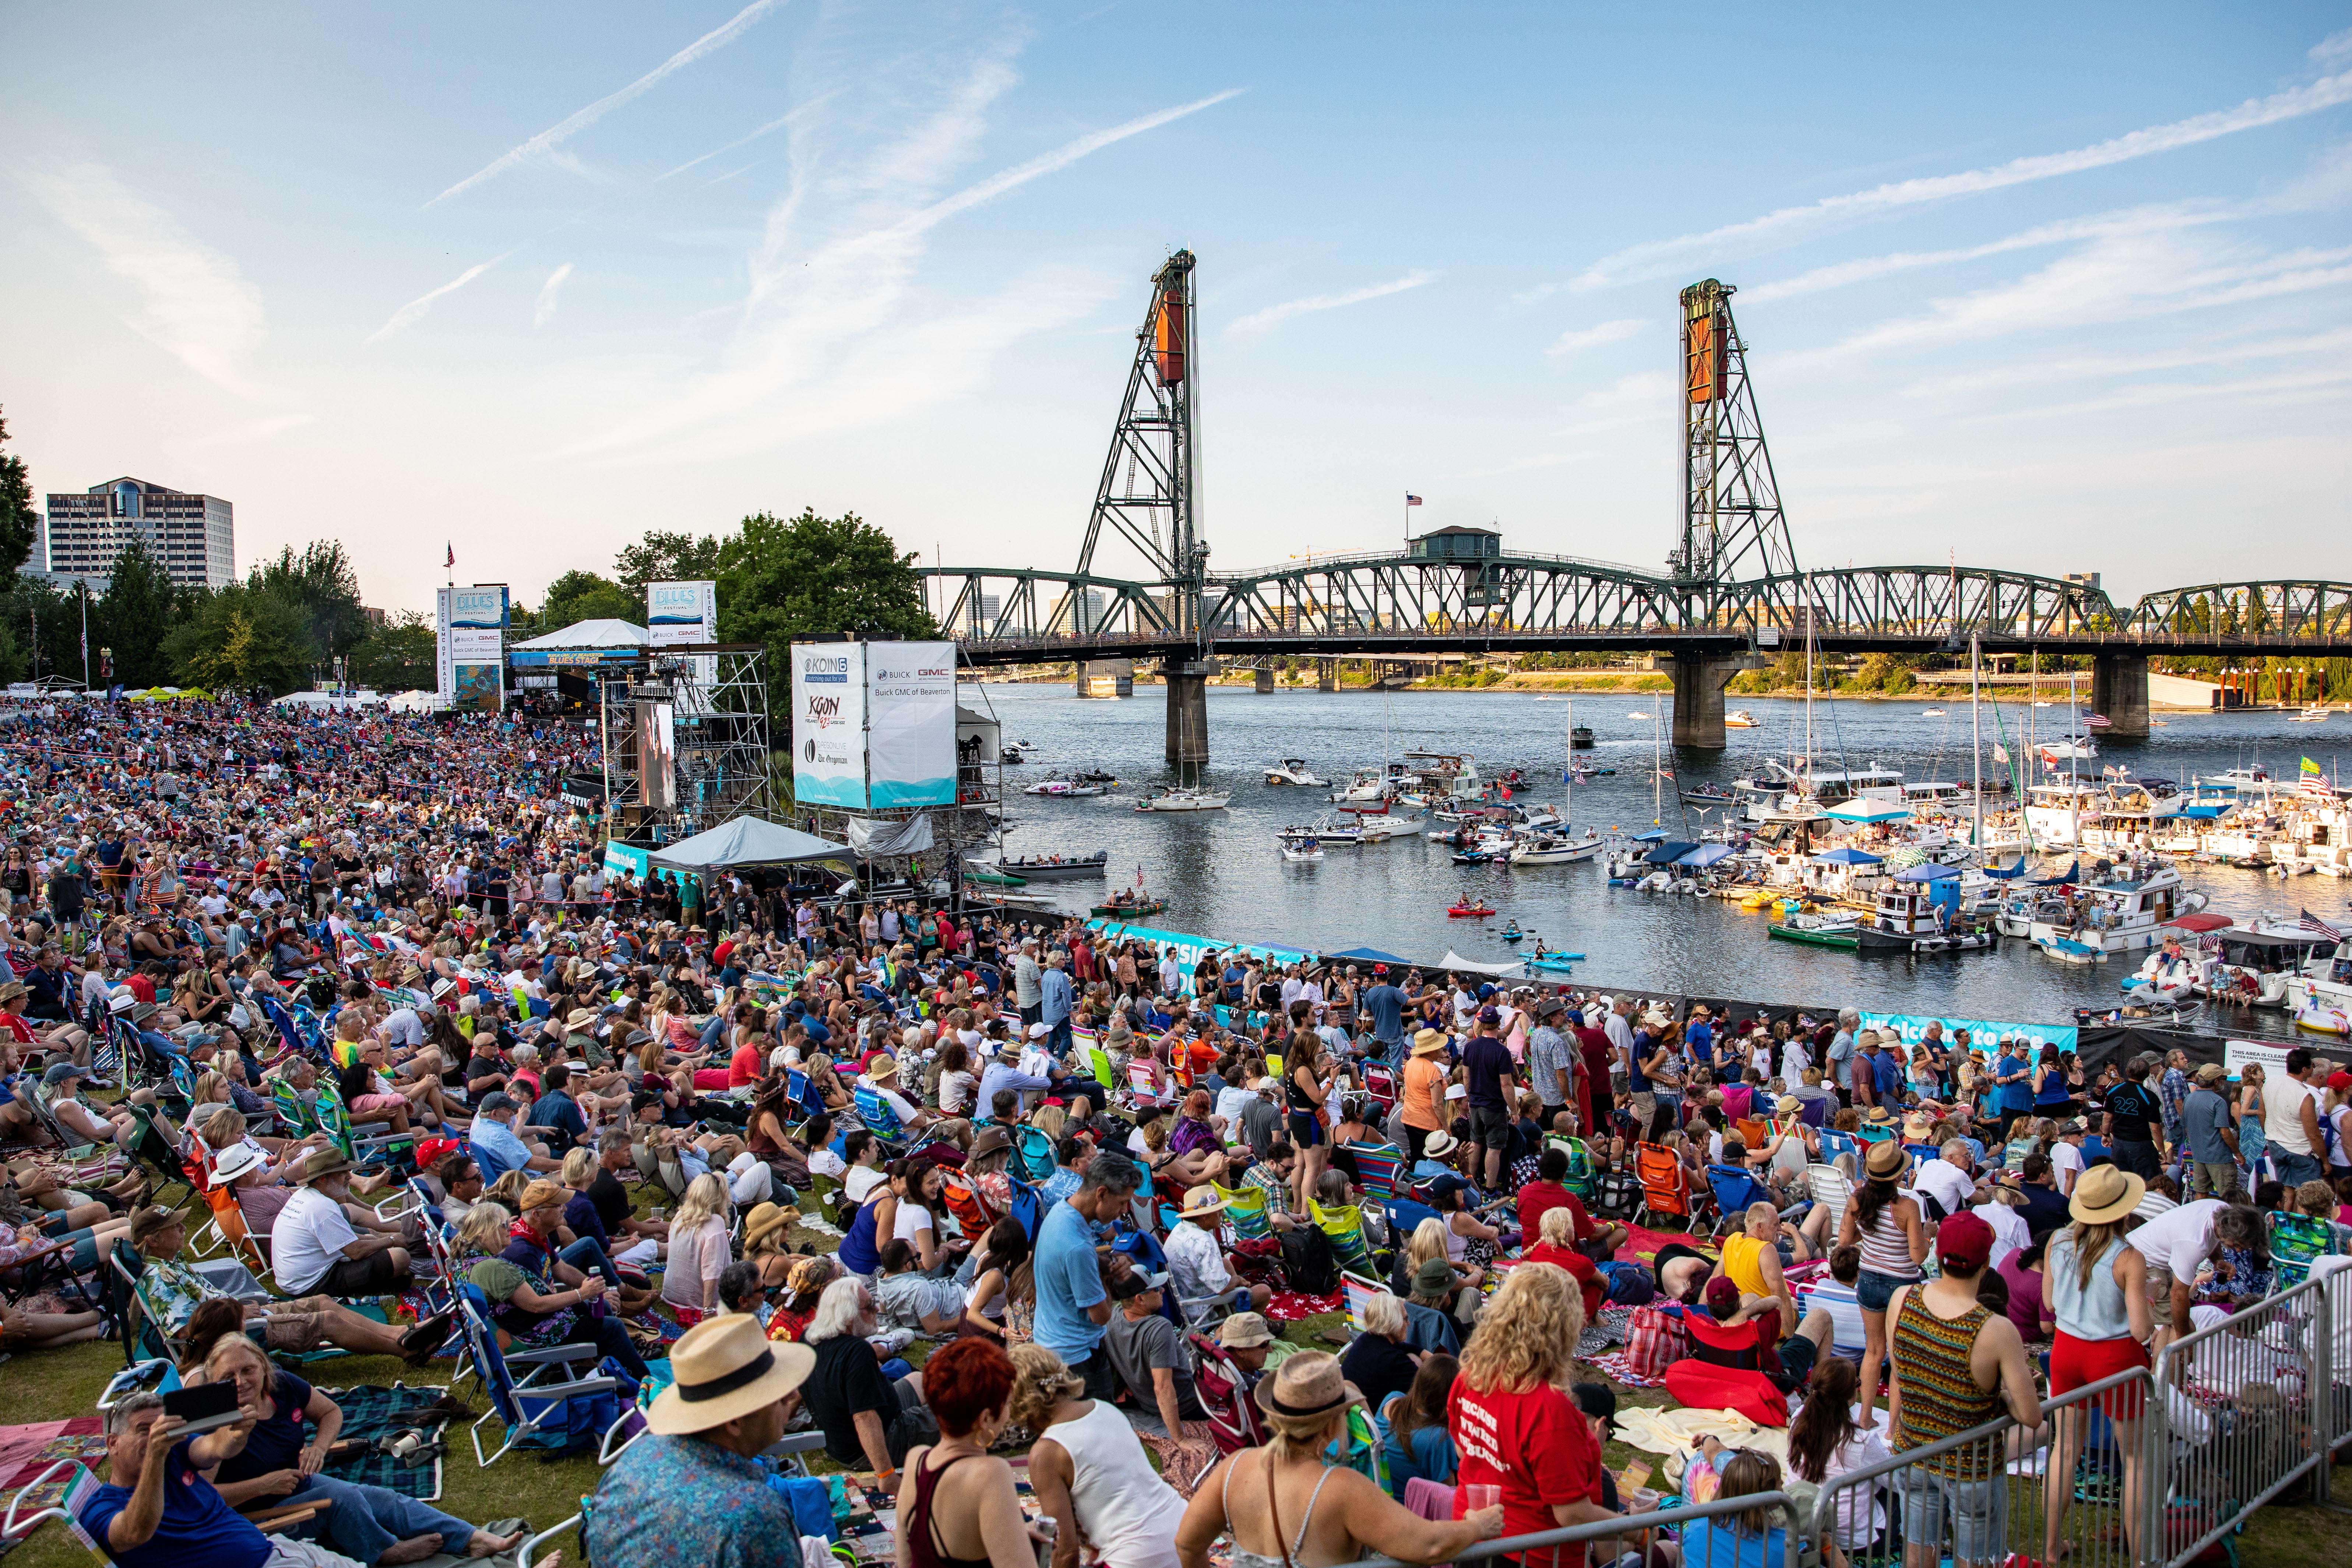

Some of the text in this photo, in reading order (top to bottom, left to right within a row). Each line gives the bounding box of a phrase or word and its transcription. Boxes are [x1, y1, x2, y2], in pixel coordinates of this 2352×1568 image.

[457, 596, 494, 609] BLUES
[655, 590, 695, 604] BLUES
[812, 658, 846, 672] KOIN 6
[809, 695, 840, 723] KGON
[817, 741, 847, 750] OREGONLIVE
[826, 755, 848, 765] Oregonian
[560, 792, 591, 808] FESTIV
[1972, 1027, 1997, 1046] to
[2114, 1096, 2138, 1116] 22
